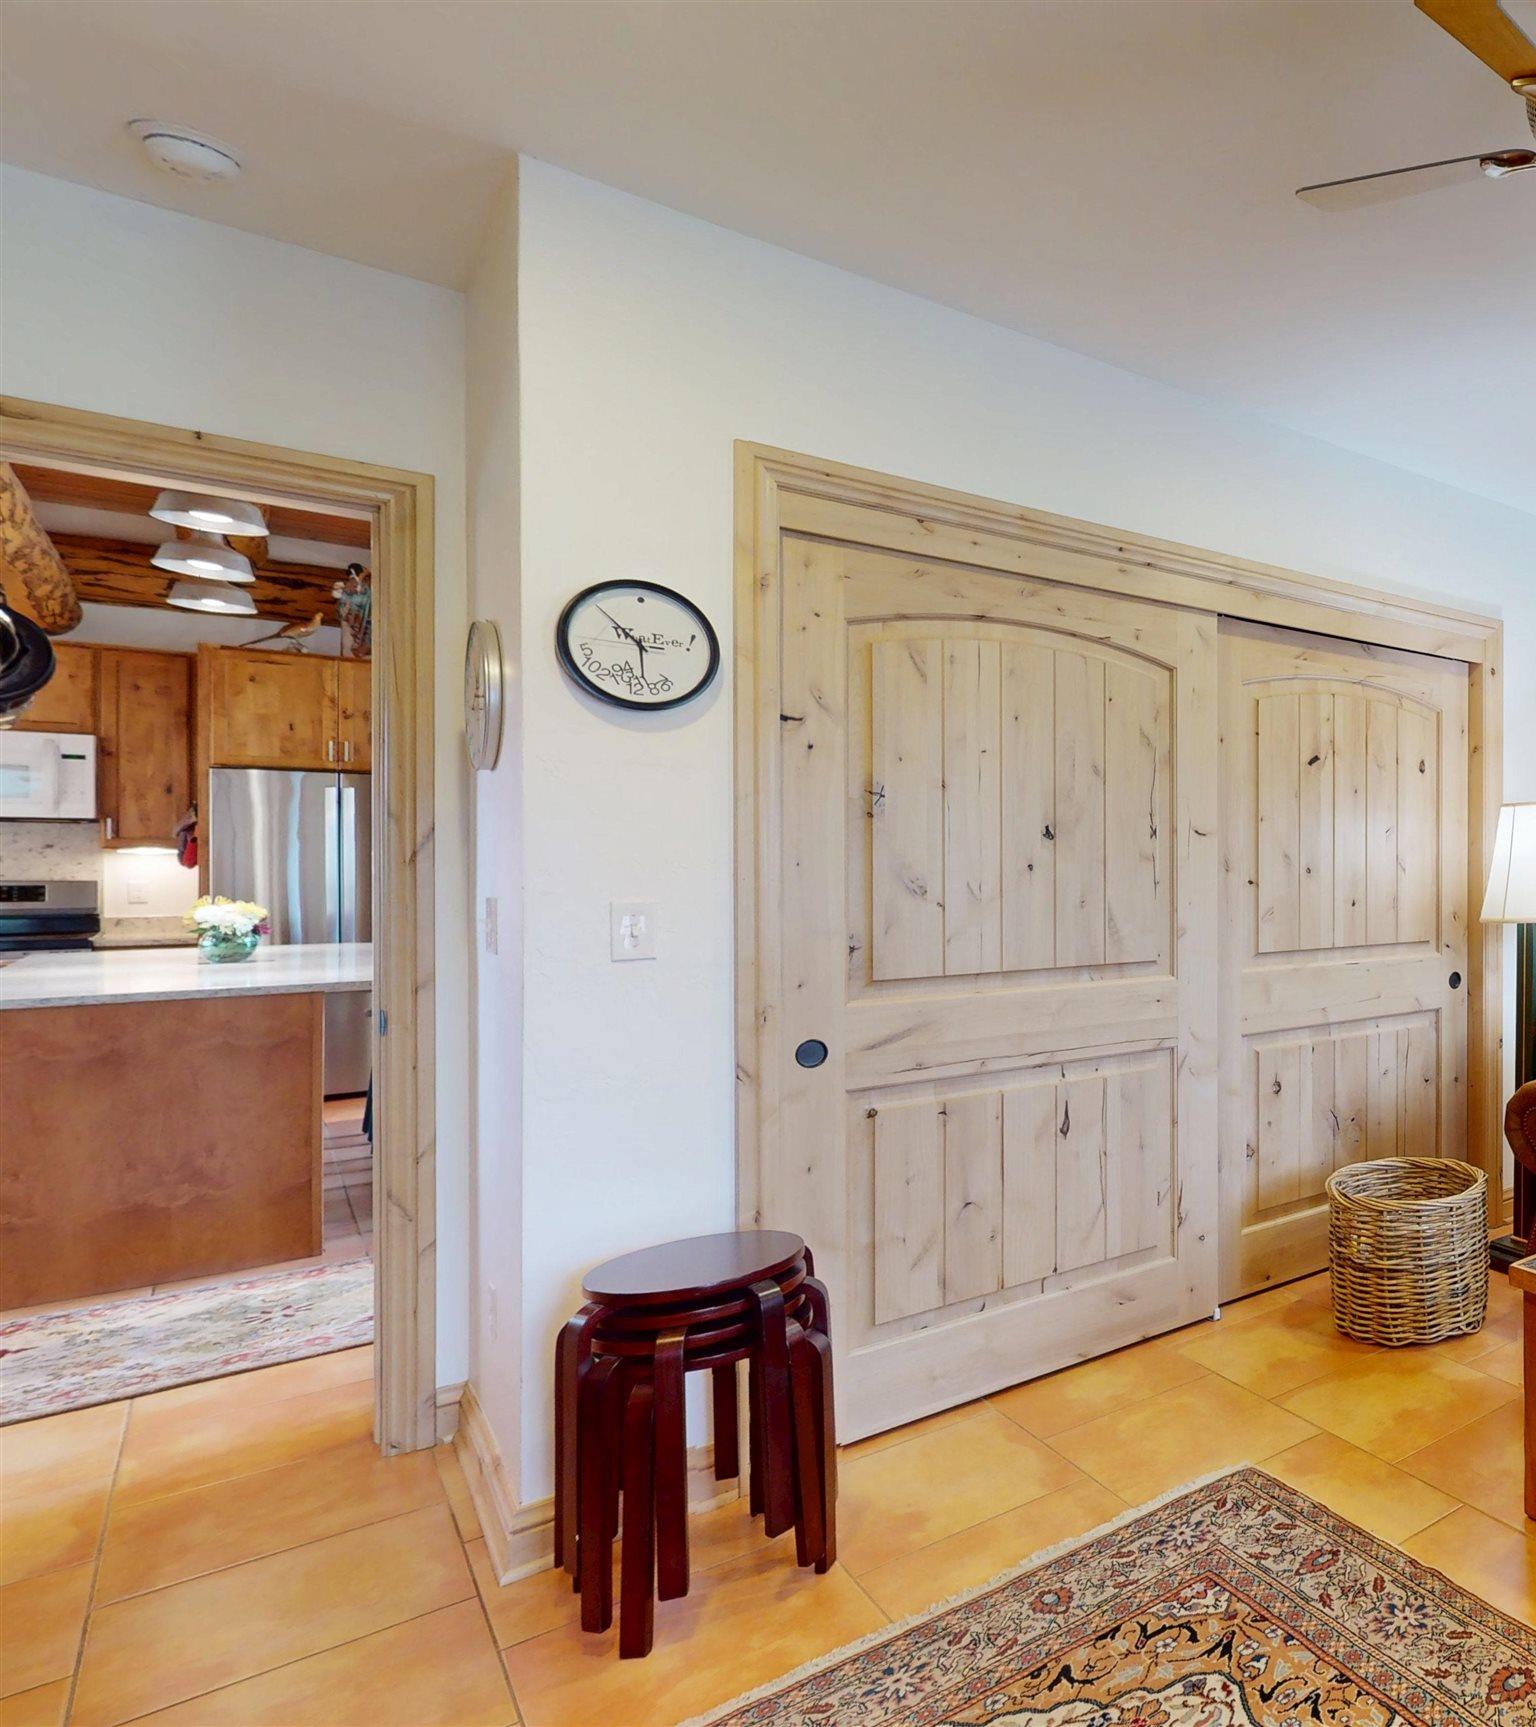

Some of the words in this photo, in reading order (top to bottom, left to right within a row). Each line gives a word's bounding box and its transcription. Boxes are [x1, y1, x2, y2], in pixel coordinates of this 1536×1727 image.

[580, 642, 593, 657] 5
[581, 657, 602, 673] 10
[611, 663, 624, 677] 9
[596, 667, 611, 681] 2
[626, 683, 644, 696] 12
[648, 682, 659, 695] 8
[661, 679, 673, 692] 6
